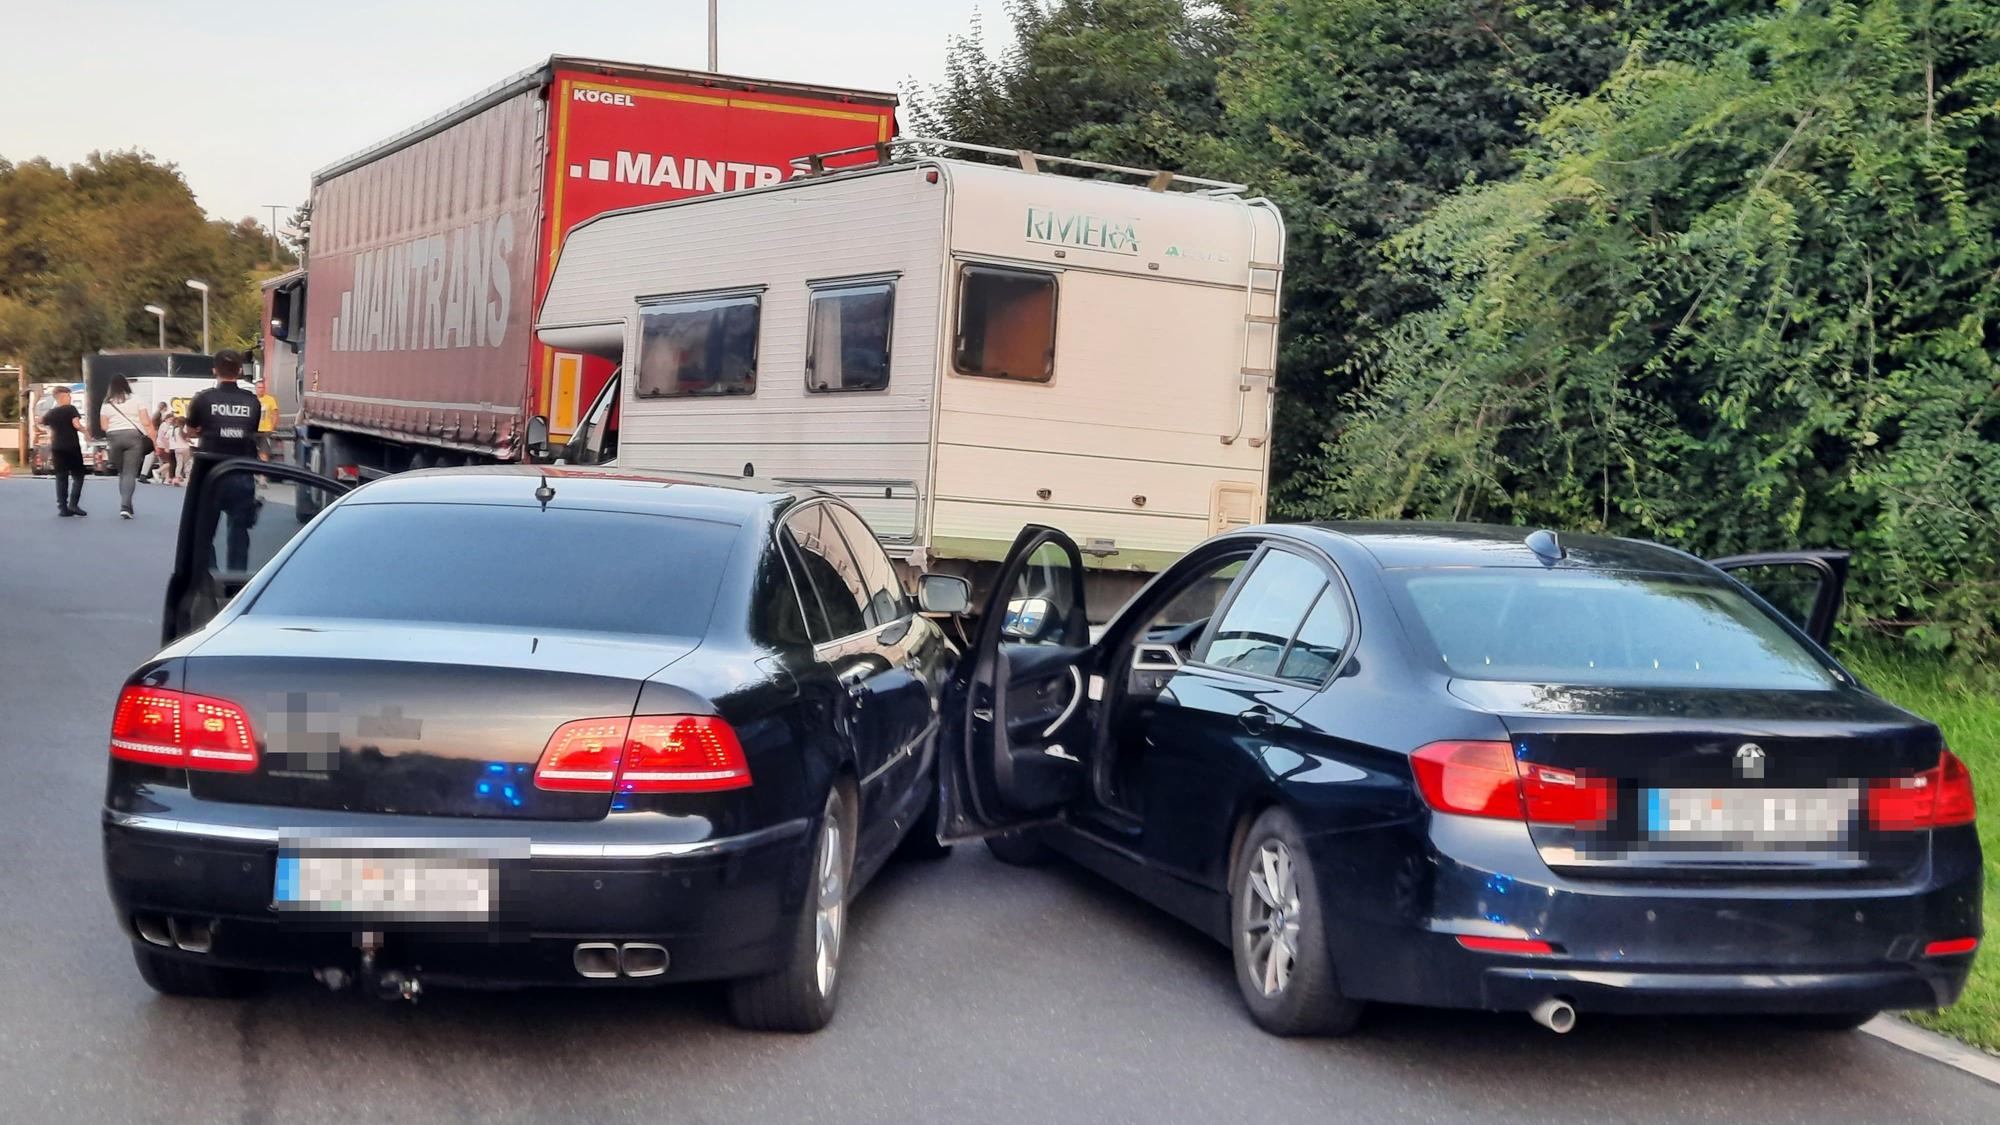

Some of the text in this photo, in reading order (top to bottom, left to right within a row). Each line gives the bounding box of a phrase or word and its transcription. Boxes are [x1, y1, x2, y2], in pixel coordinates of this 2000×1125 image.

[573, 88, 635, 107] KÖGEL
[616, 151, 806, 193] MAINTR
[1026, 207, 1138, 252] RIVIERA
[351, 213, 514, 351] MAINTRANS
[211, 403, 250, 417] POLIZEI
